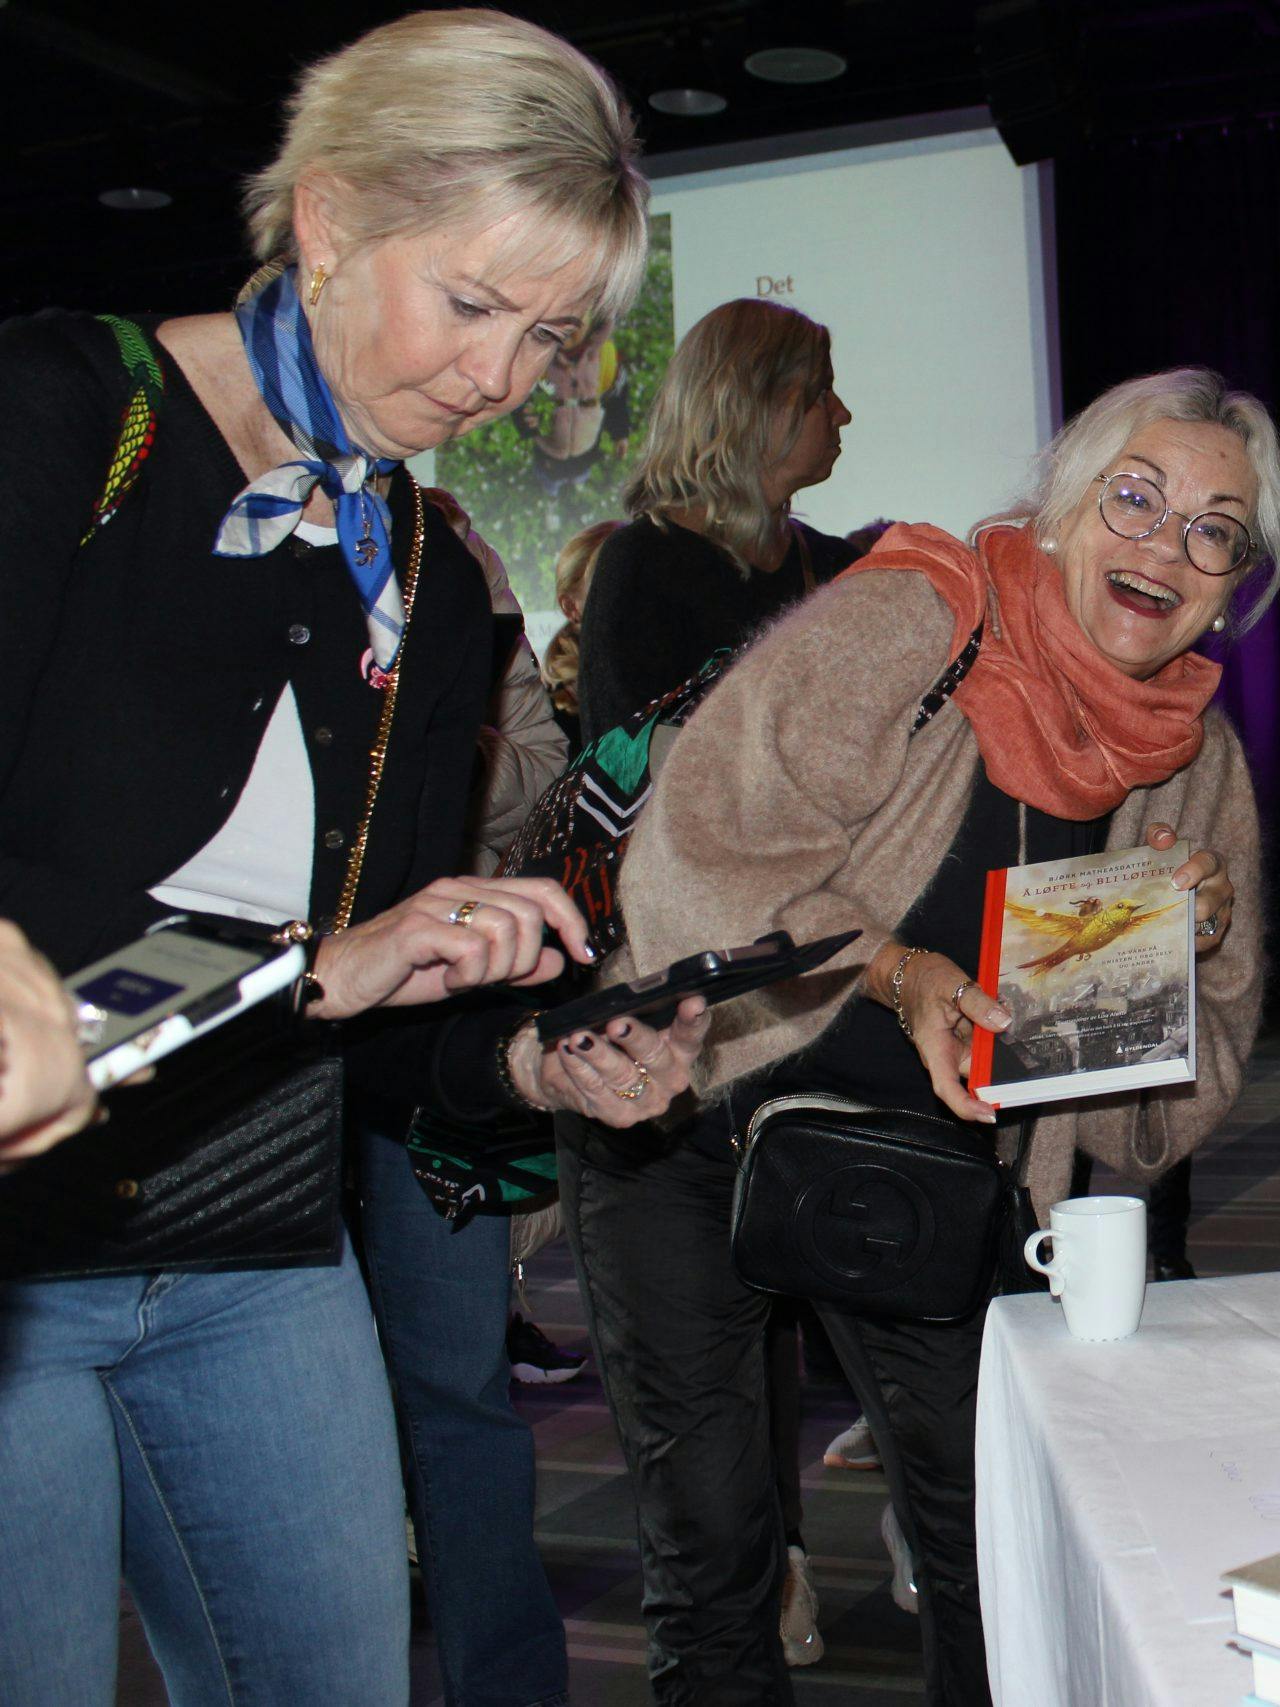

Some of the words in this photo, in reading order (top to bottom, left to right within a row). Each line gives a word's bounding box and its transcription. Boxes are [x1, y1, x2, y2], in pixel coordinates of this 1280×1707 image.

[756, 274, 794, 297] Det
[1035, 882, 1077, 896] LØFTE
[1096, 875, 1118, 886] BLI
[1123, 866, 1175, 881] LØFTET
